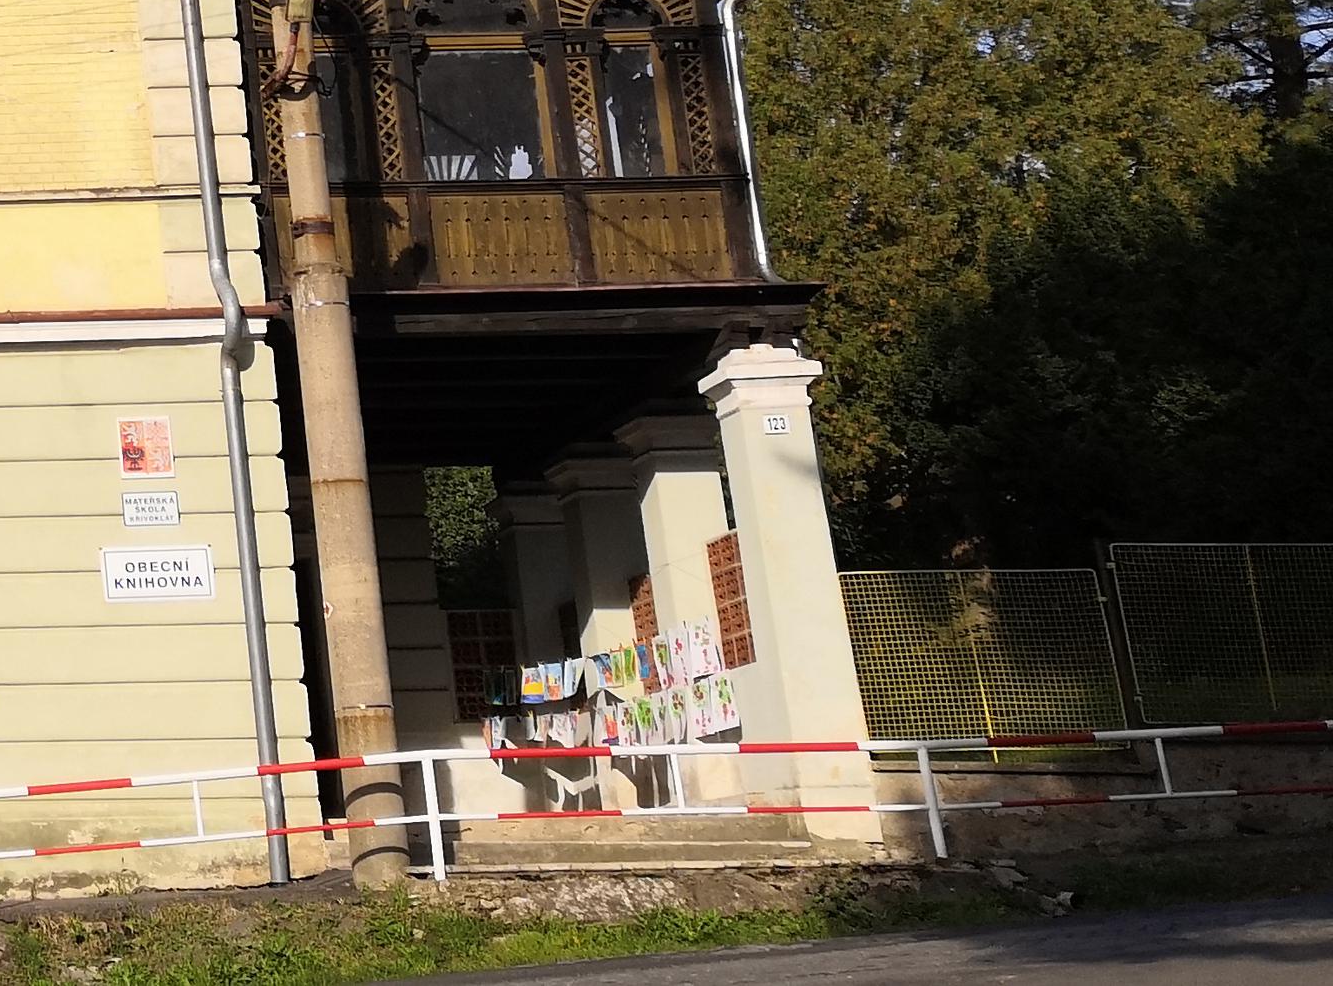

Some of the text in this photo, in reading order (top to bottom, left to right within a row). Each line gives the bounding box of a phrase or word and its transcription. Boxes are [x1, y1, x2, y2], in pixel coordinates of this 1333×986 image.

[767, 417, 786, 431] 123
[134, 505, 166, 513] ŠKOLA
[125, 557, 189, 573] OBECNÍ
[114, 576, 204, 589] KNIHOVNA
